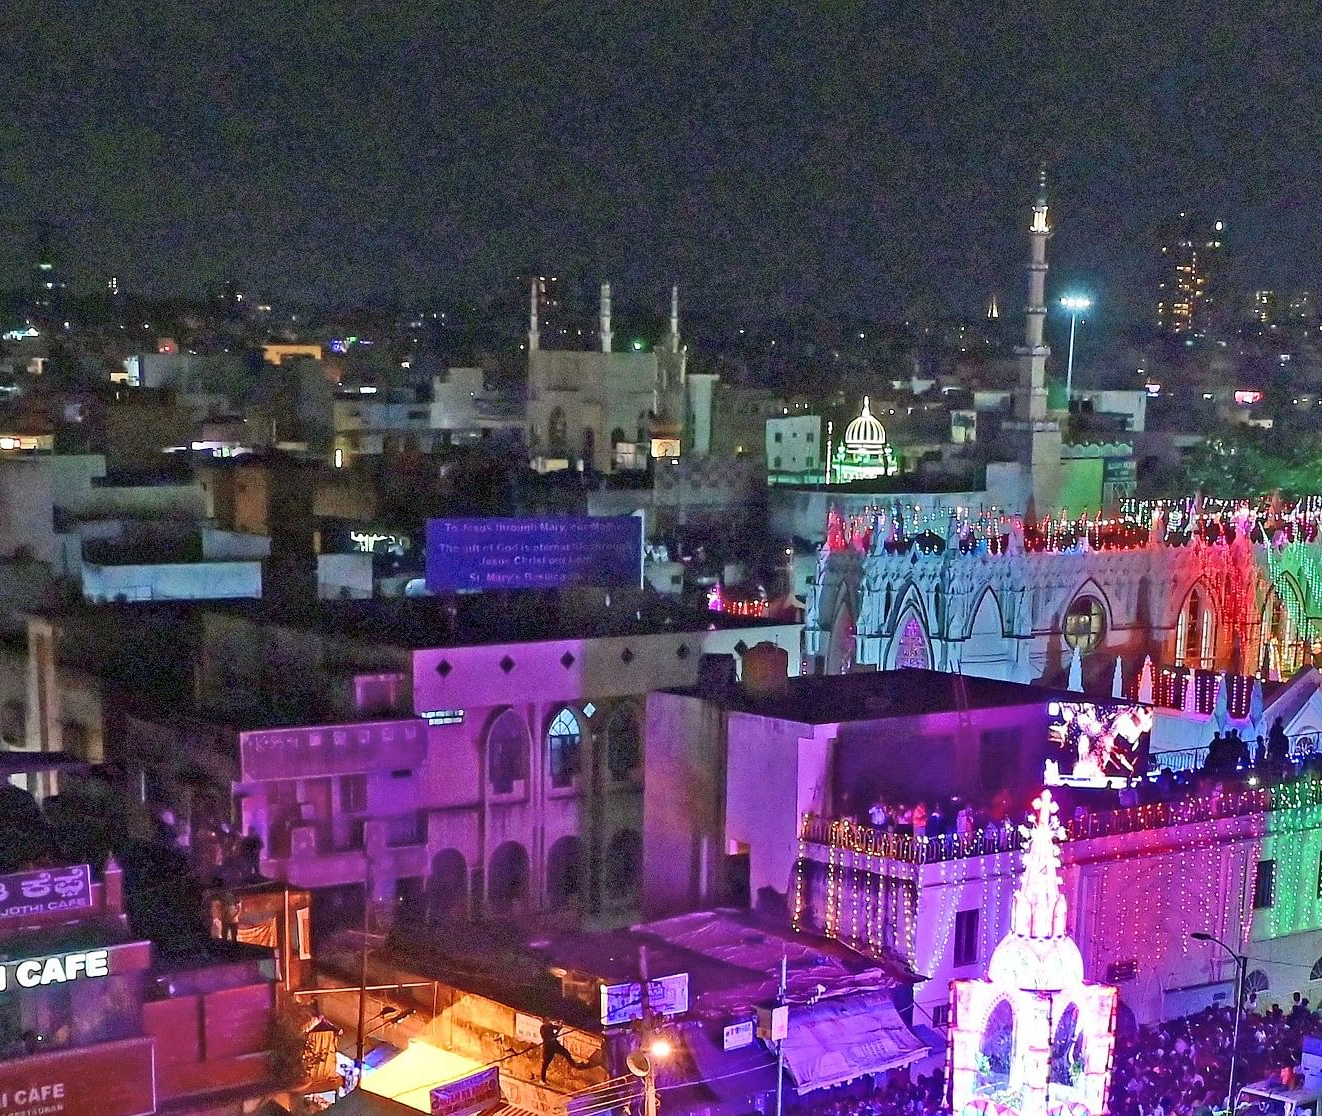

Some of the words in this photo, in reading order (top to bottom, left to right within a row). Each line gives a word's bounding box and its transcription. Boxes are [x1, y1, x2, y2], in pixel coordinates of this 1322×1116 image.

[514, 556, 545, 565] Christ
[0, 903, 44, 917] JOTHI
[47, 898, 86, 912] CAFE
[15, 949, 109, 988] CAFE
[14, 1083, 65, 1105] CAFE
